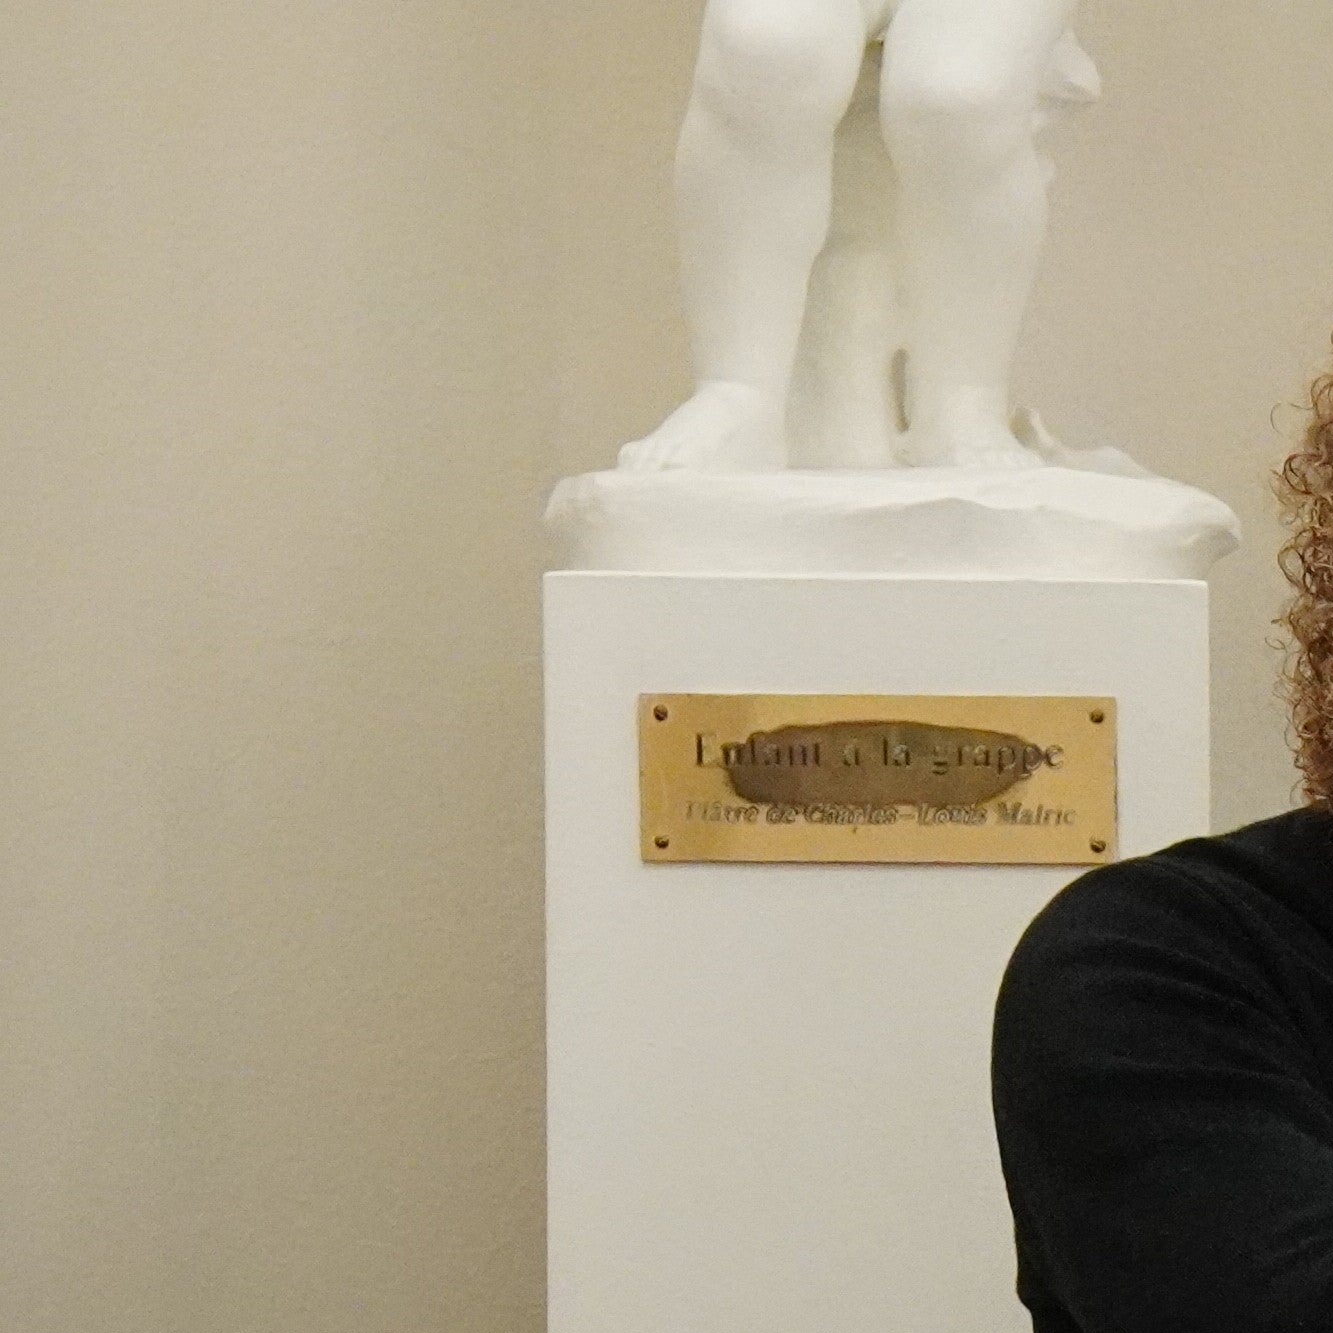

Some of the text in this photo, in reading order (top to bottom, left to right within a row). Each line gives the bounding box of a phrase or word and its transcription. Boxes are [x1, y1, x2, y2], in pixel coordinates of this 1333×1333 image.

[695, 732, 820, 769] Enfant
[881, 736, 912, 768] la
[932, 741, 1064, 782] grappe
